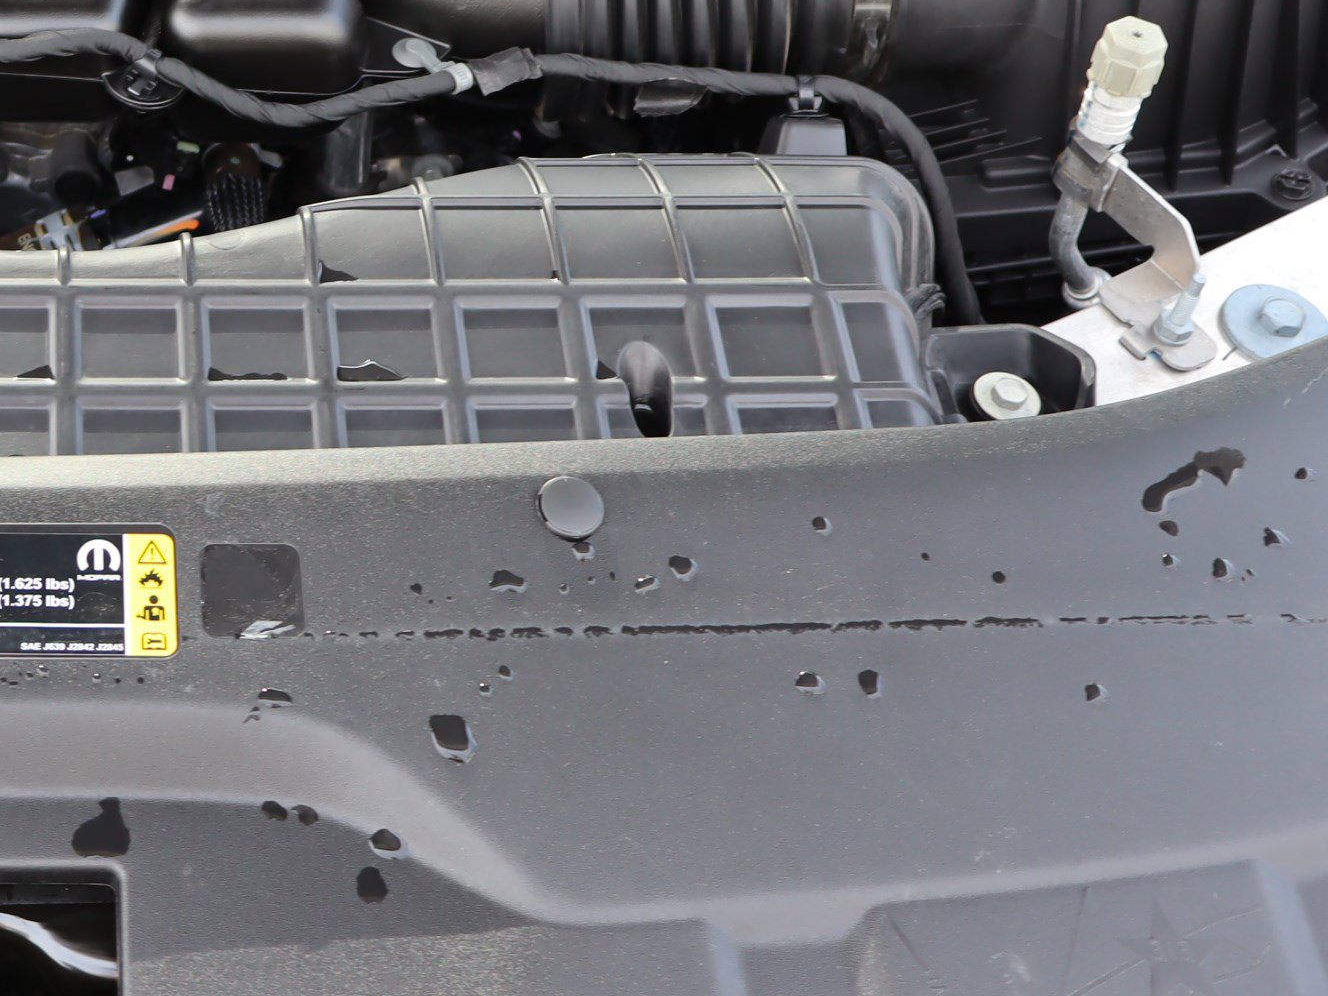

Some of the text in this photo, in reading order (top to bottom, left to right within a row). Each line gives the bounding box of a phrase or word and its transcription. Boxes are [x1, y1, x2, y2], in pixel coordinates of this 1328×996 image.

[45, 577, 75, 592] lbs)
[45, 594, 75, 610] lbs)
[20, 642, 42, 651] SAE
